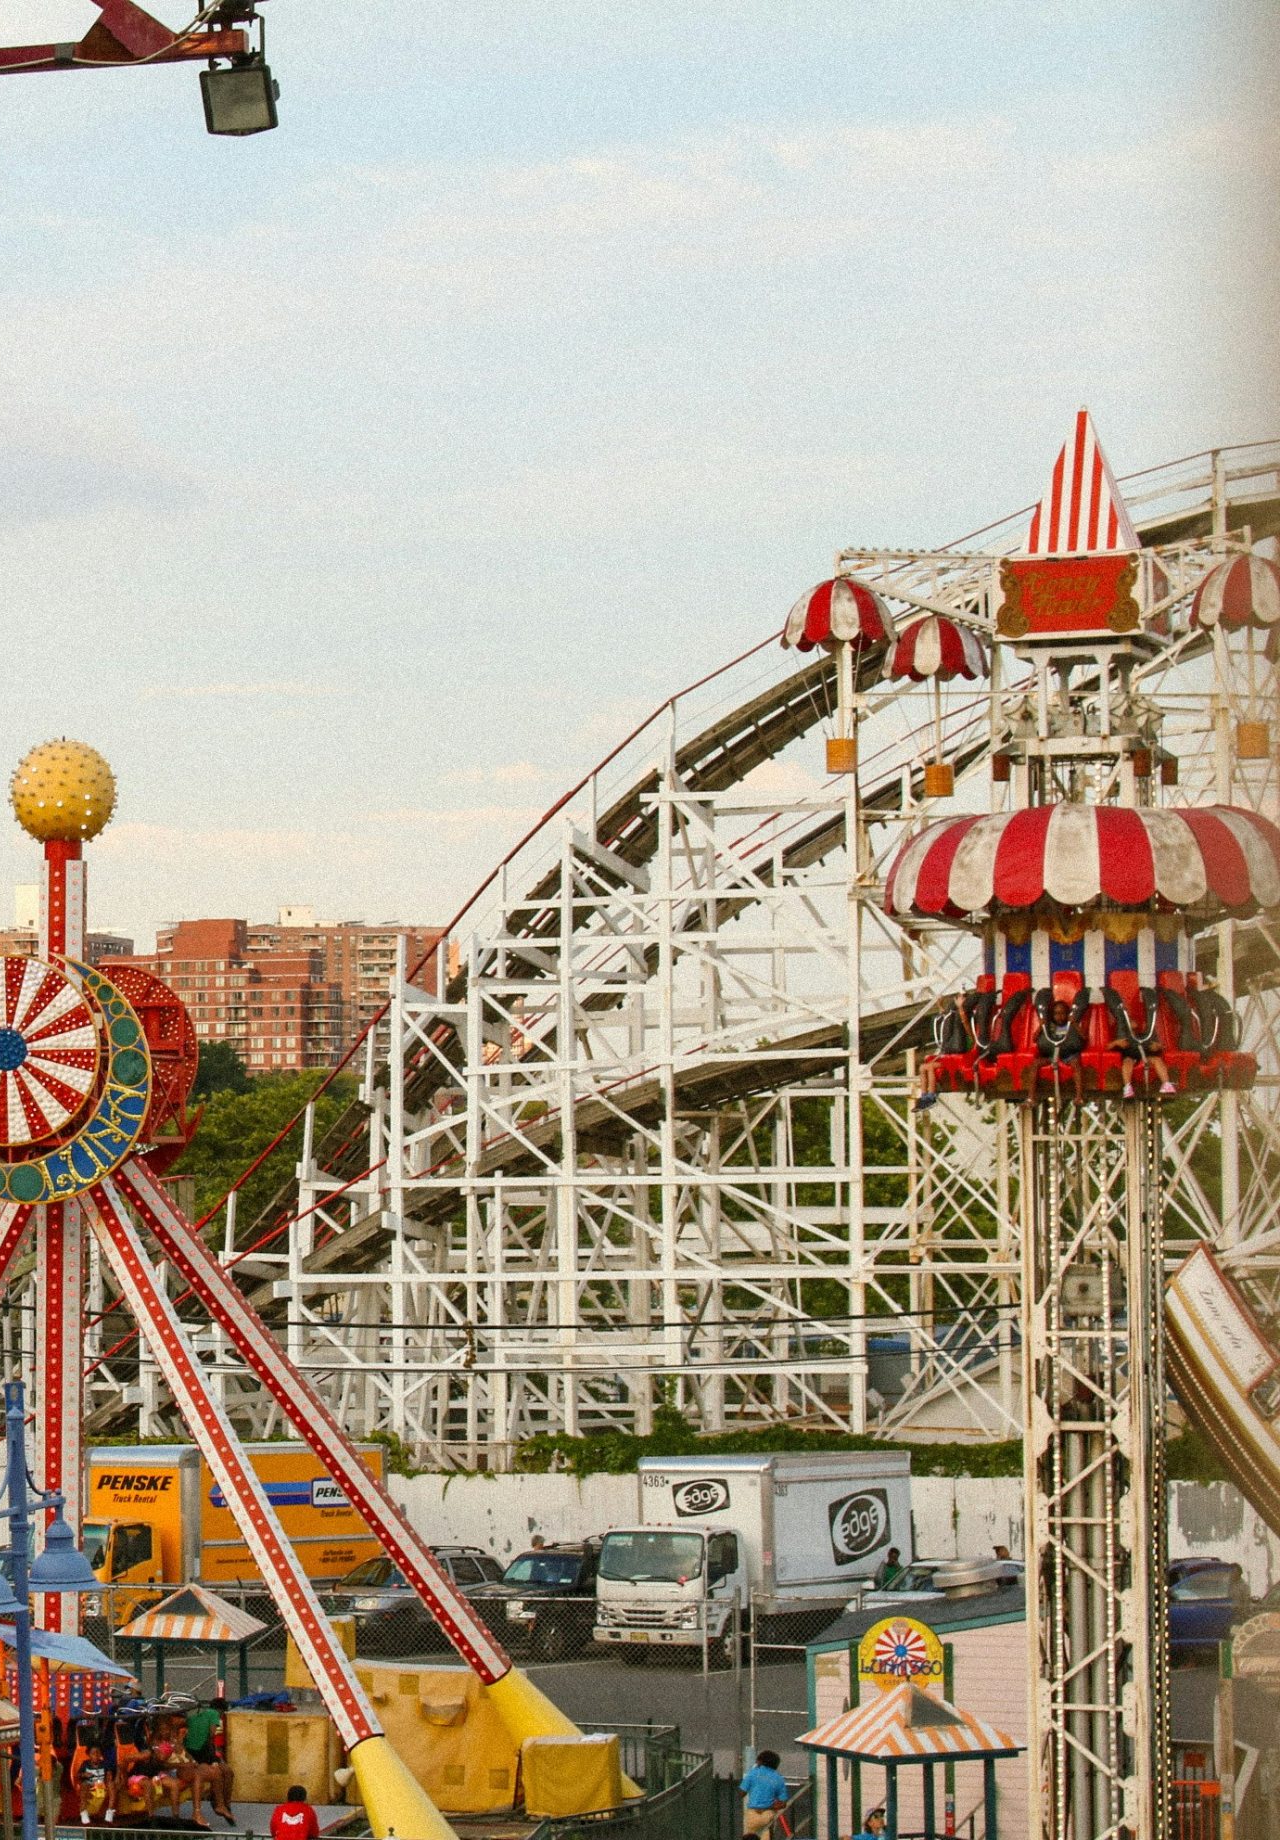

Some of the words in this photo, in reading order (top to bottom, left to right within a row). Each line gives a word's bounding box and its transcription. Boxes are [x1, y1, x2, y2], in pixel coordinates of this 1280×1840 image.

[38, 1082, 146, 1201] LUNA
[97, 1475, 173, 1491] PENSKE
[642, 1476, 666, 1488] 4363
[113, 1494, 131, 1503] Truck
[133, 1494, 158, 1503] Rental
[315, 1487, 343, 1498] PENS
[684, 1487, 718, 1506] edge
[841, 1505, 878, 1543] edge
[910, 1660, 943, 1676] 360
